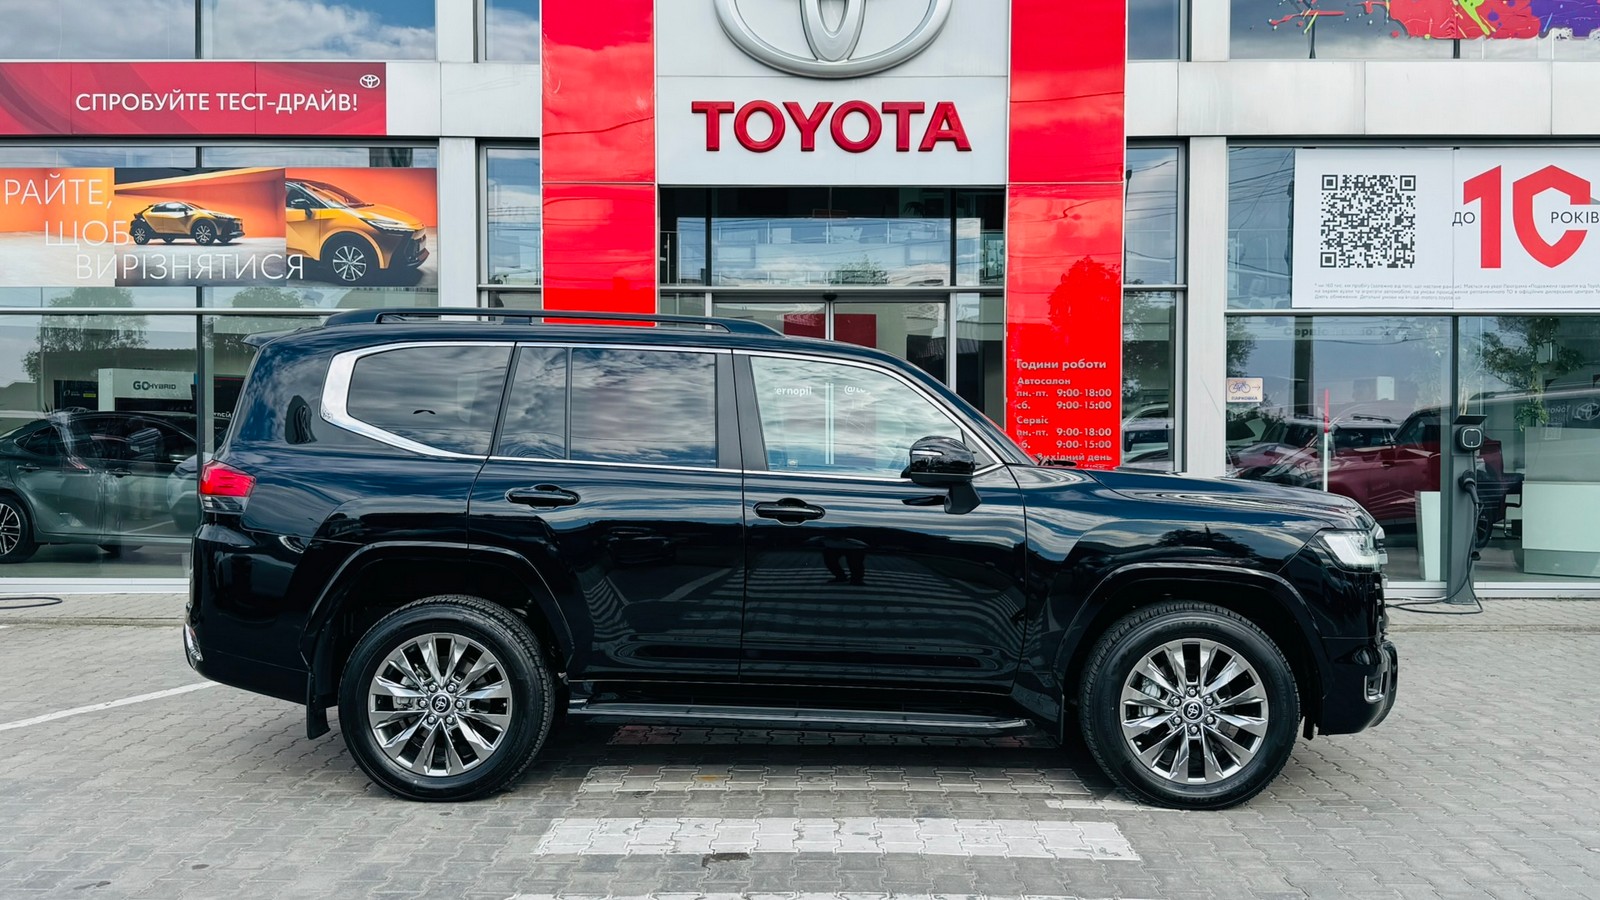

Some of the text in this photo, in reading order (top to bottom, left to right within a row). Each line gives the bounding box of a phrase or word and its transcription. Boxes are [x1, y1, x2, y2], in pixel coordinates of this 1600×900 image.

[76, 89, 358, 114] СПРОБУЙТЕ ТЕСТ-ДРАЙВ!
[691, 100, 972, 153] TOYOTA
[4, 173, 113, 209] РАЙТЕ,
[1452, 165, 1600, 268] ДО 10 РОКІВ
[45, 220, 131, 251] ЩОБ
[76, 254, 304, 280] ВИРІЗНЯТИСЯ
[1016, 359, 1107, 371] Години роботи
[1017, 377, 1071, 385] Автосалон
[774, 386, 812, 397] ernopil
[1016, 401, 1031, 409] сб.
[1016, 415, 1049, 426] Сервіс
[1018, 440, 1031, 449] б.
[1087, 454, 1112, 462] день
